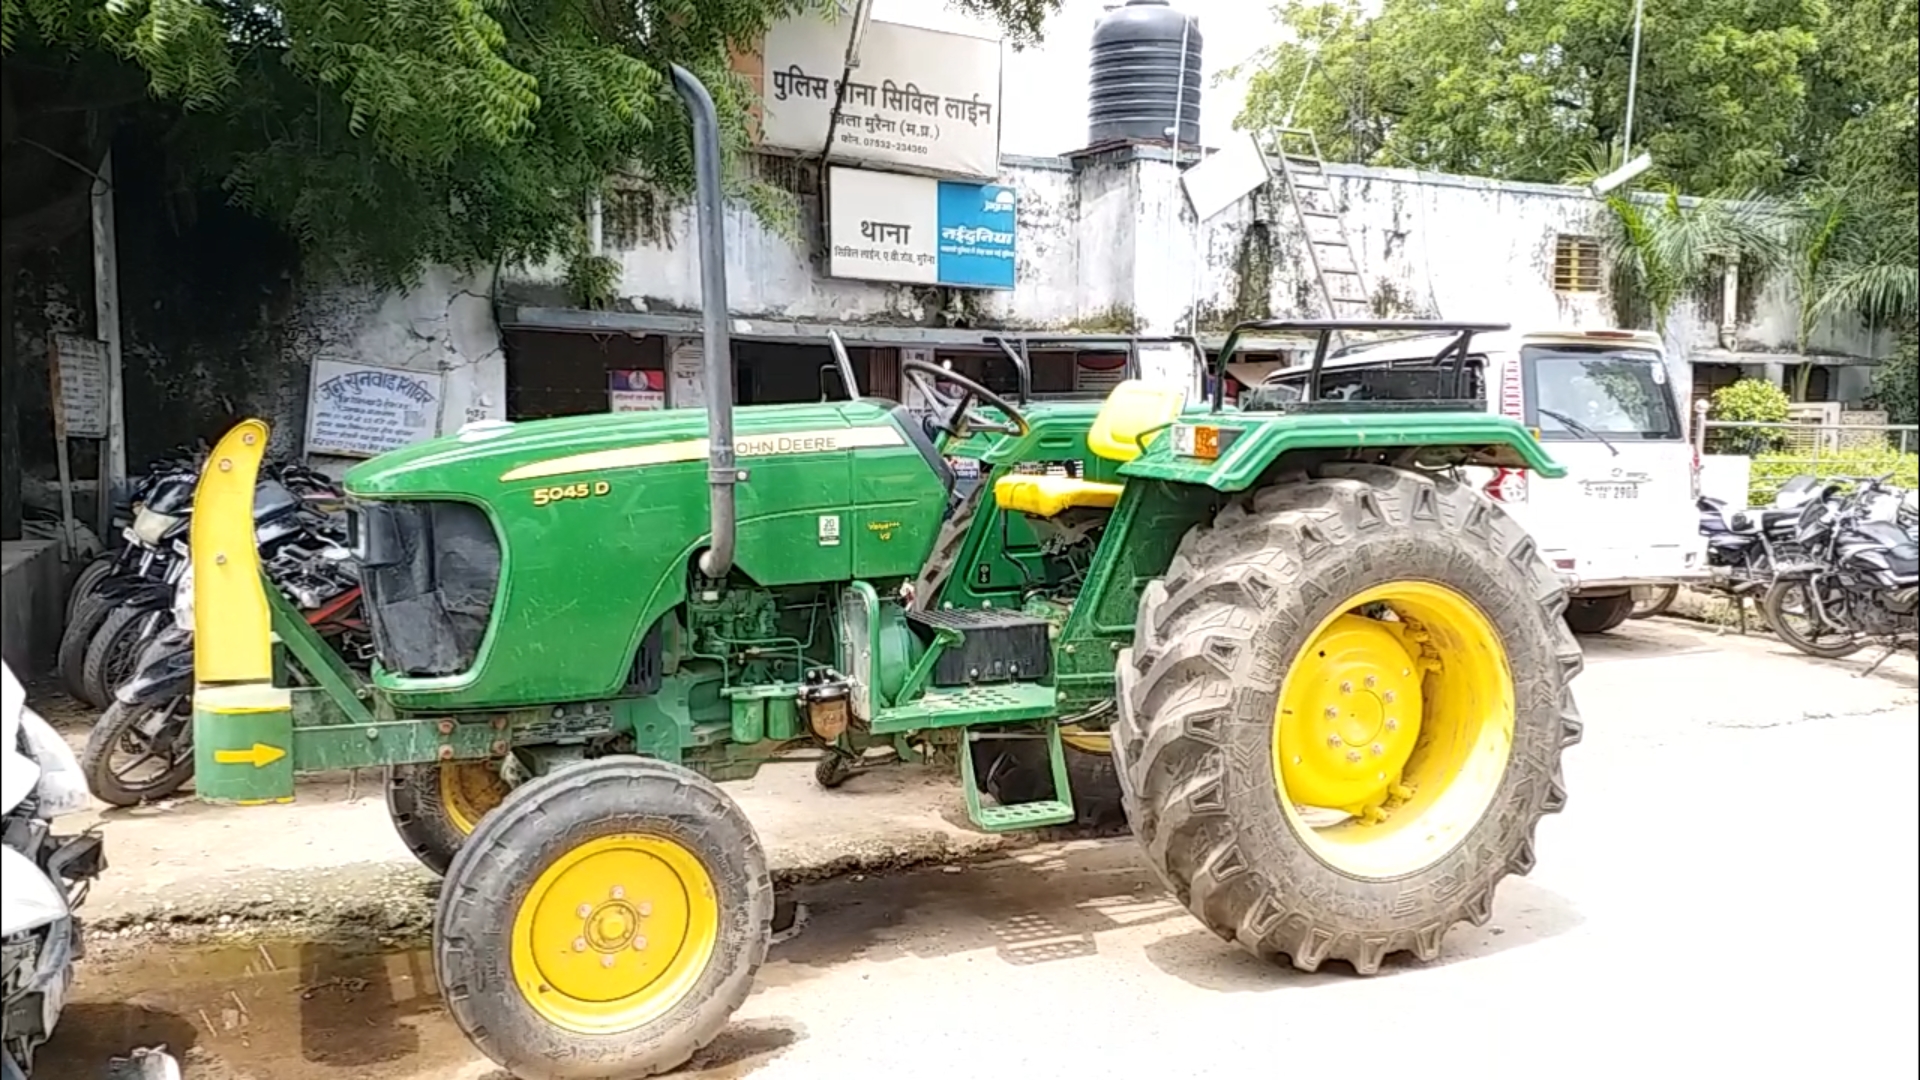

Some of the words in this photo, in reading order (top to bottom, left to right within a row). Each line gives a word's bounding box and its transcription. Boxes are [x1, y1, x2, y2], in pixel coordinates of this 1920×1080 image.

[773, 64, 829, 101] पुलिस
[881, 79, 939, 117] सिविल
[945, 93, 993, 127] लाईन
[866, 113, 896, 134] मुरैना
[861, 219, 912, 245] थाना
[735, 440, 775, 456] OHN
[533, 483, 590, 507] 5045
[594, 481, 611, 497] D
